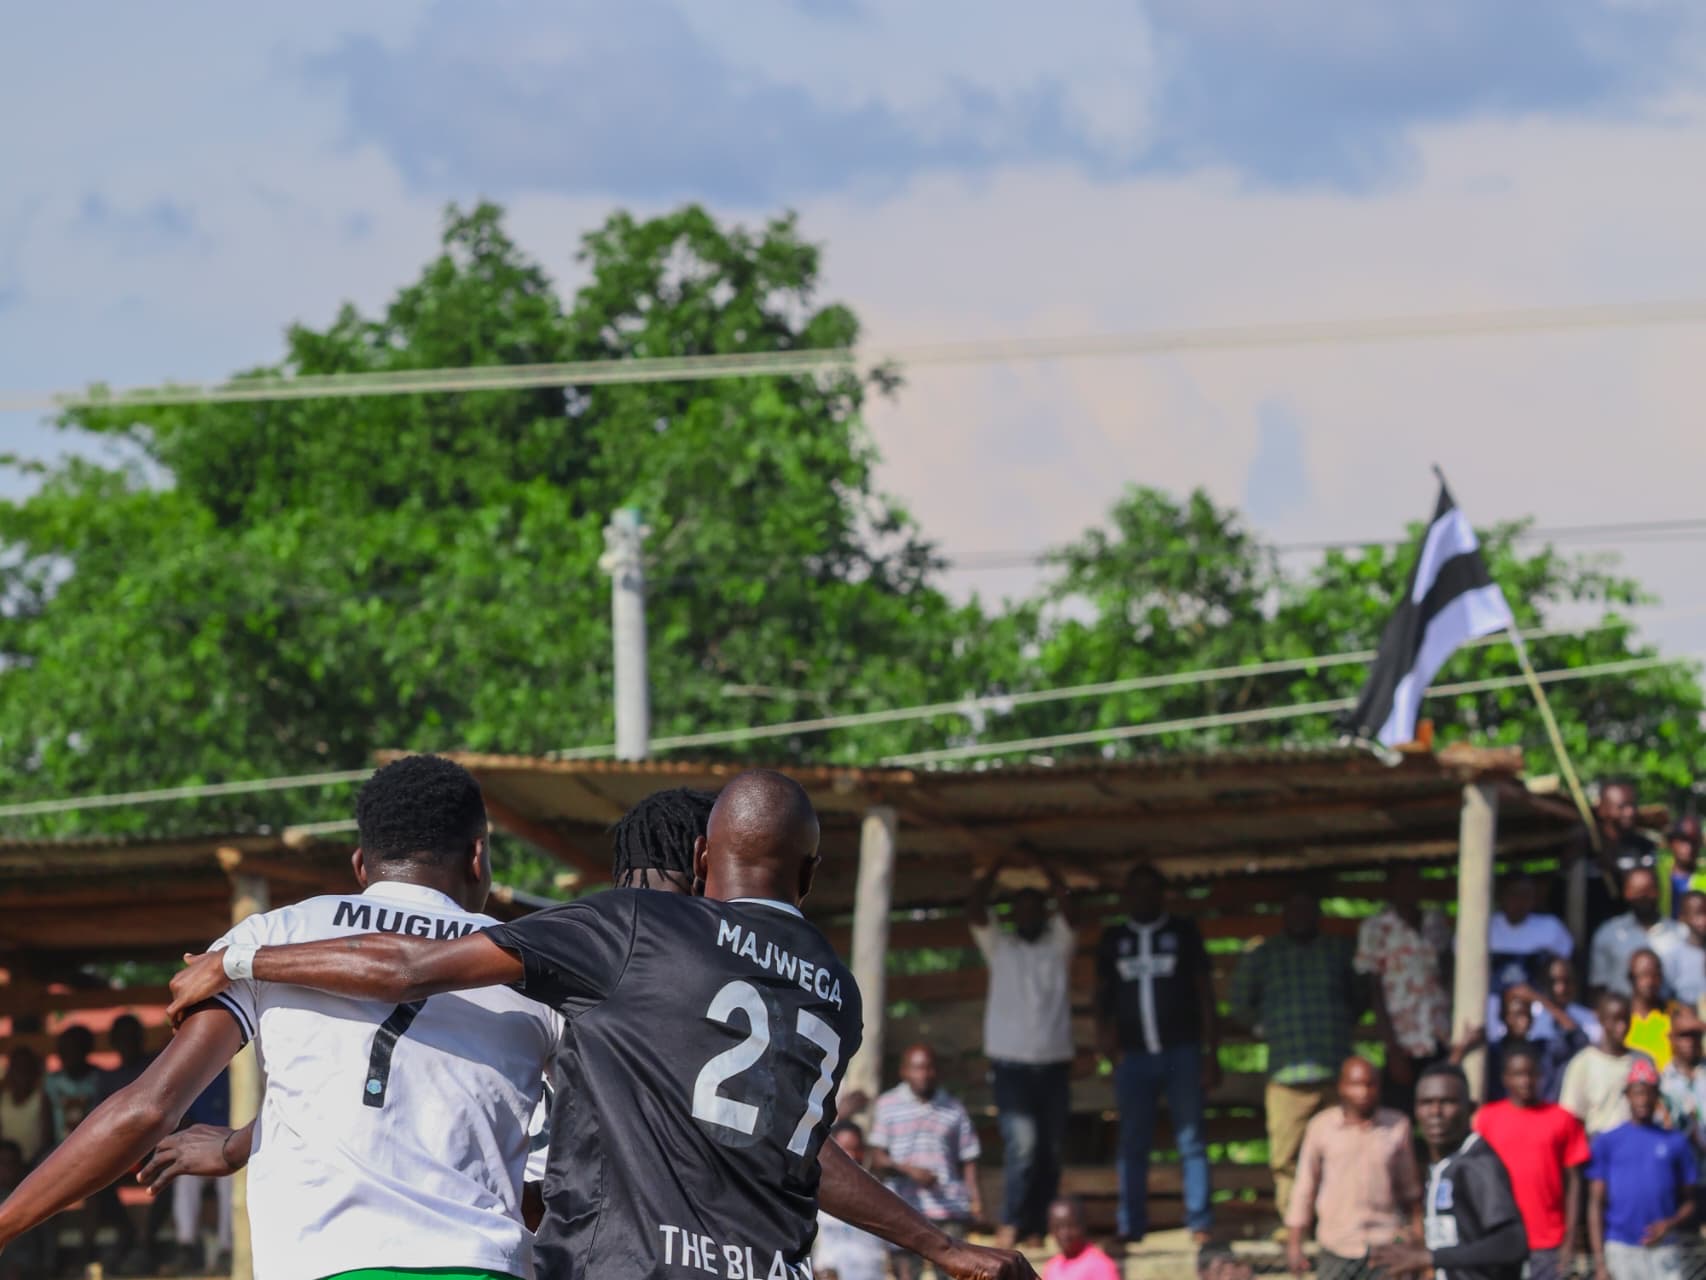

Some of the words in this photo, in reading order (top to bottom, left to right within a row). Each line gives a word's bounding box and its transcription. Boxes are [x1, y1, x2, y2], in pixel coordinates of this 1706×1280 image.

[717, 919, 843, 1011] MAJWEGA
[692, 980, 841, 1157] 27
[659, 1224, 718, 1275] THE
